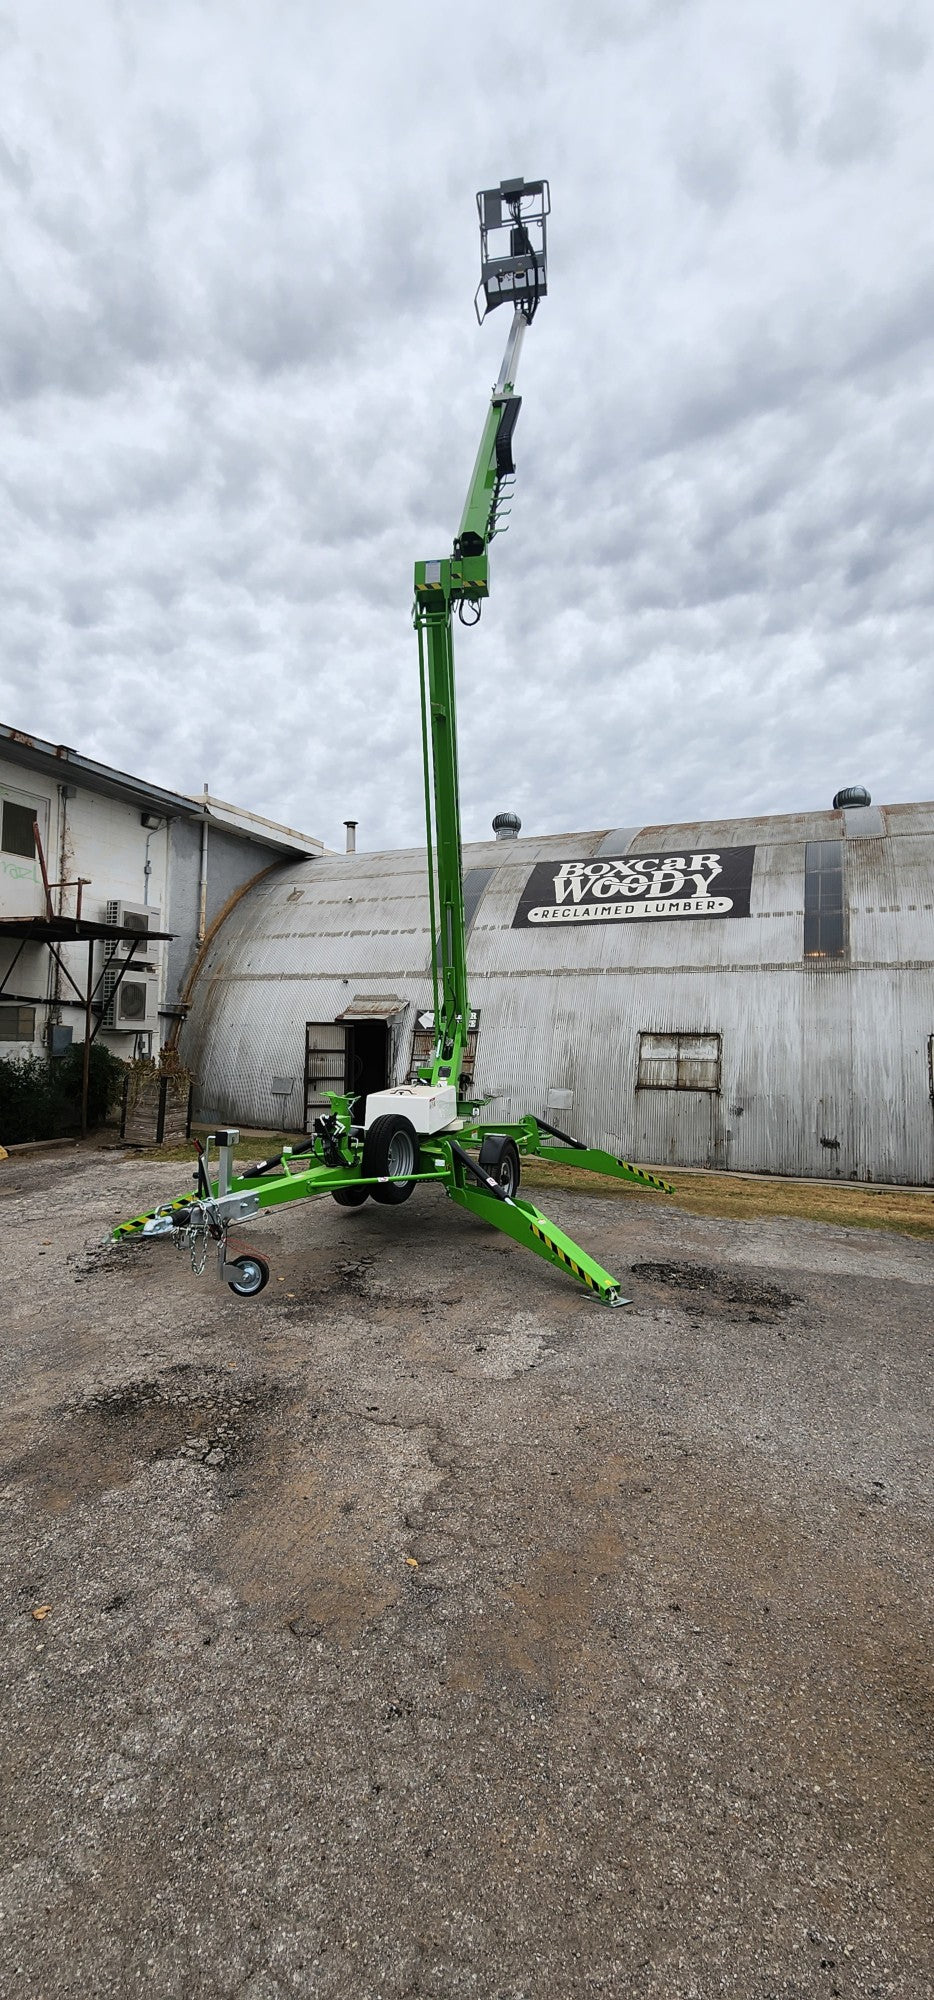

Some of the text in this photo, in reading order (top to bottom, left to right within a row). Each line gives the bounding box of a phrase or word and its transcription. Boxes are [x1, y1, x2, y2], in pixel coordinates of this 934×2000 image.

[552, 869, 722, 903] WOODY
[541, 900, 716, 919] RECLAIMED LUMBER
